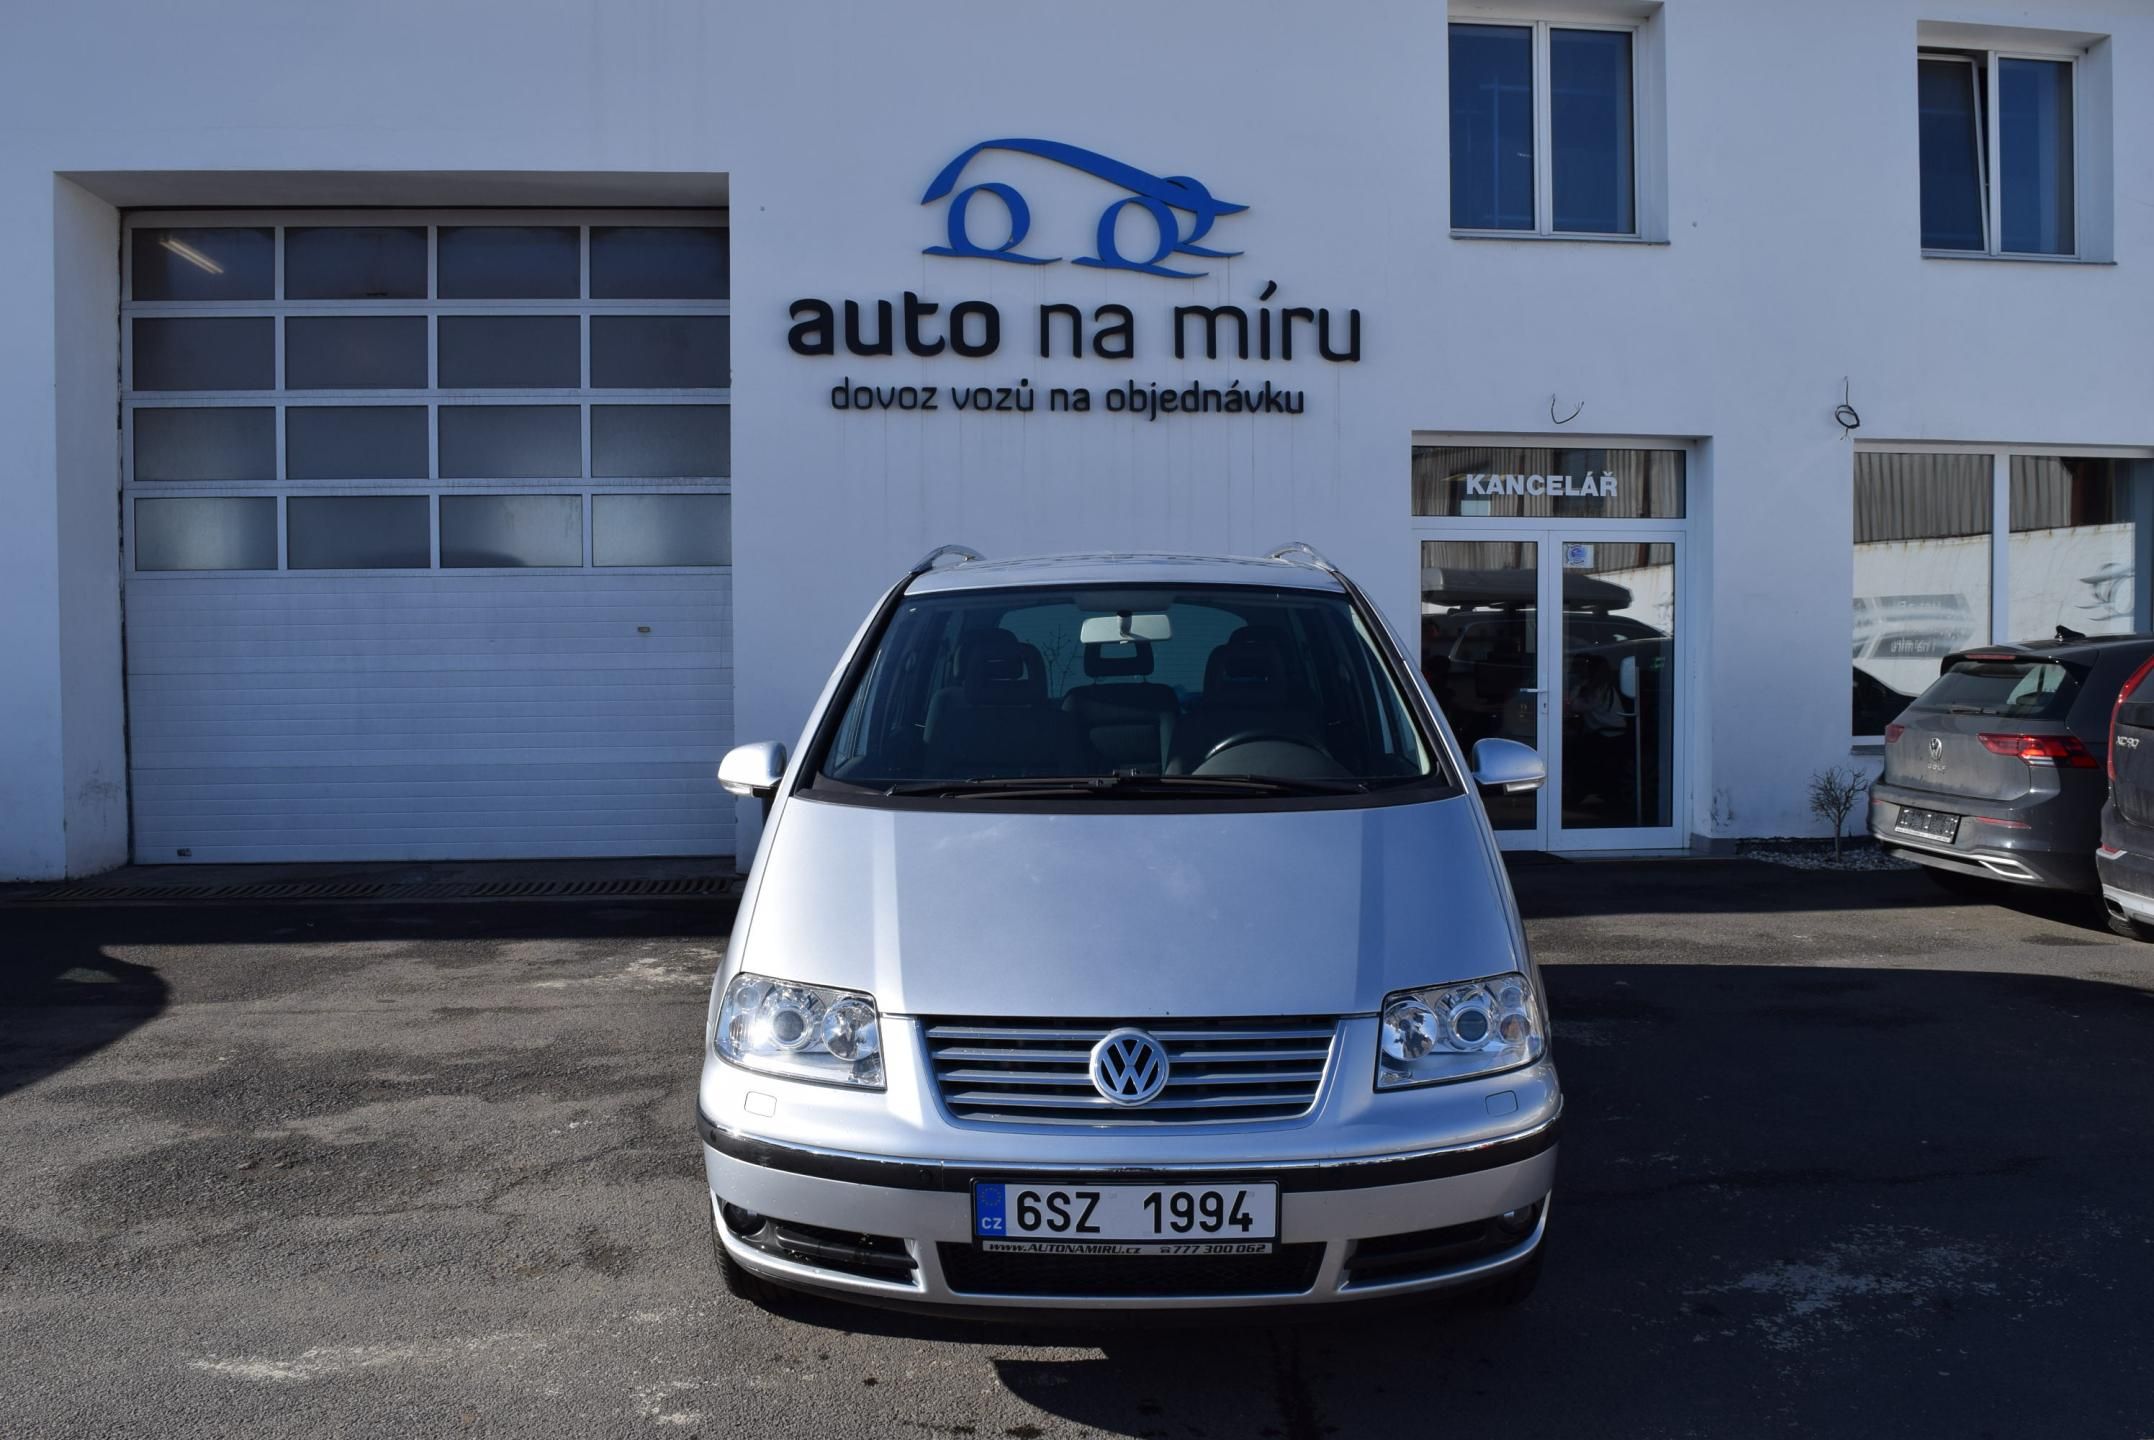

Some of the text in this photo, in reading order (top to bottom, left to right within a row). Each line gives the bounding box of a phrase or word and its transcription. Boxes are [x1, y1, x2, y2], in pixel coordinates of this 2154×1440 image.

[788, 280, 1361, 362] auto na míru
[831, 377, 1304, 421] dovoz vozů na objednávku
[1466, 471, 1618, 497] KANCELÁŘ
[2115, 735, 2141, 749] XC90
[981, 1217, 1002, 1230] CZ
[1016, 1190, 1253, 1233] 6SZ 1994
[1173, 1245, 1200, 1254] 777
[1203, 1245, 1232, 1254] 300
[1236, 1244, 1267, 1253] 062
